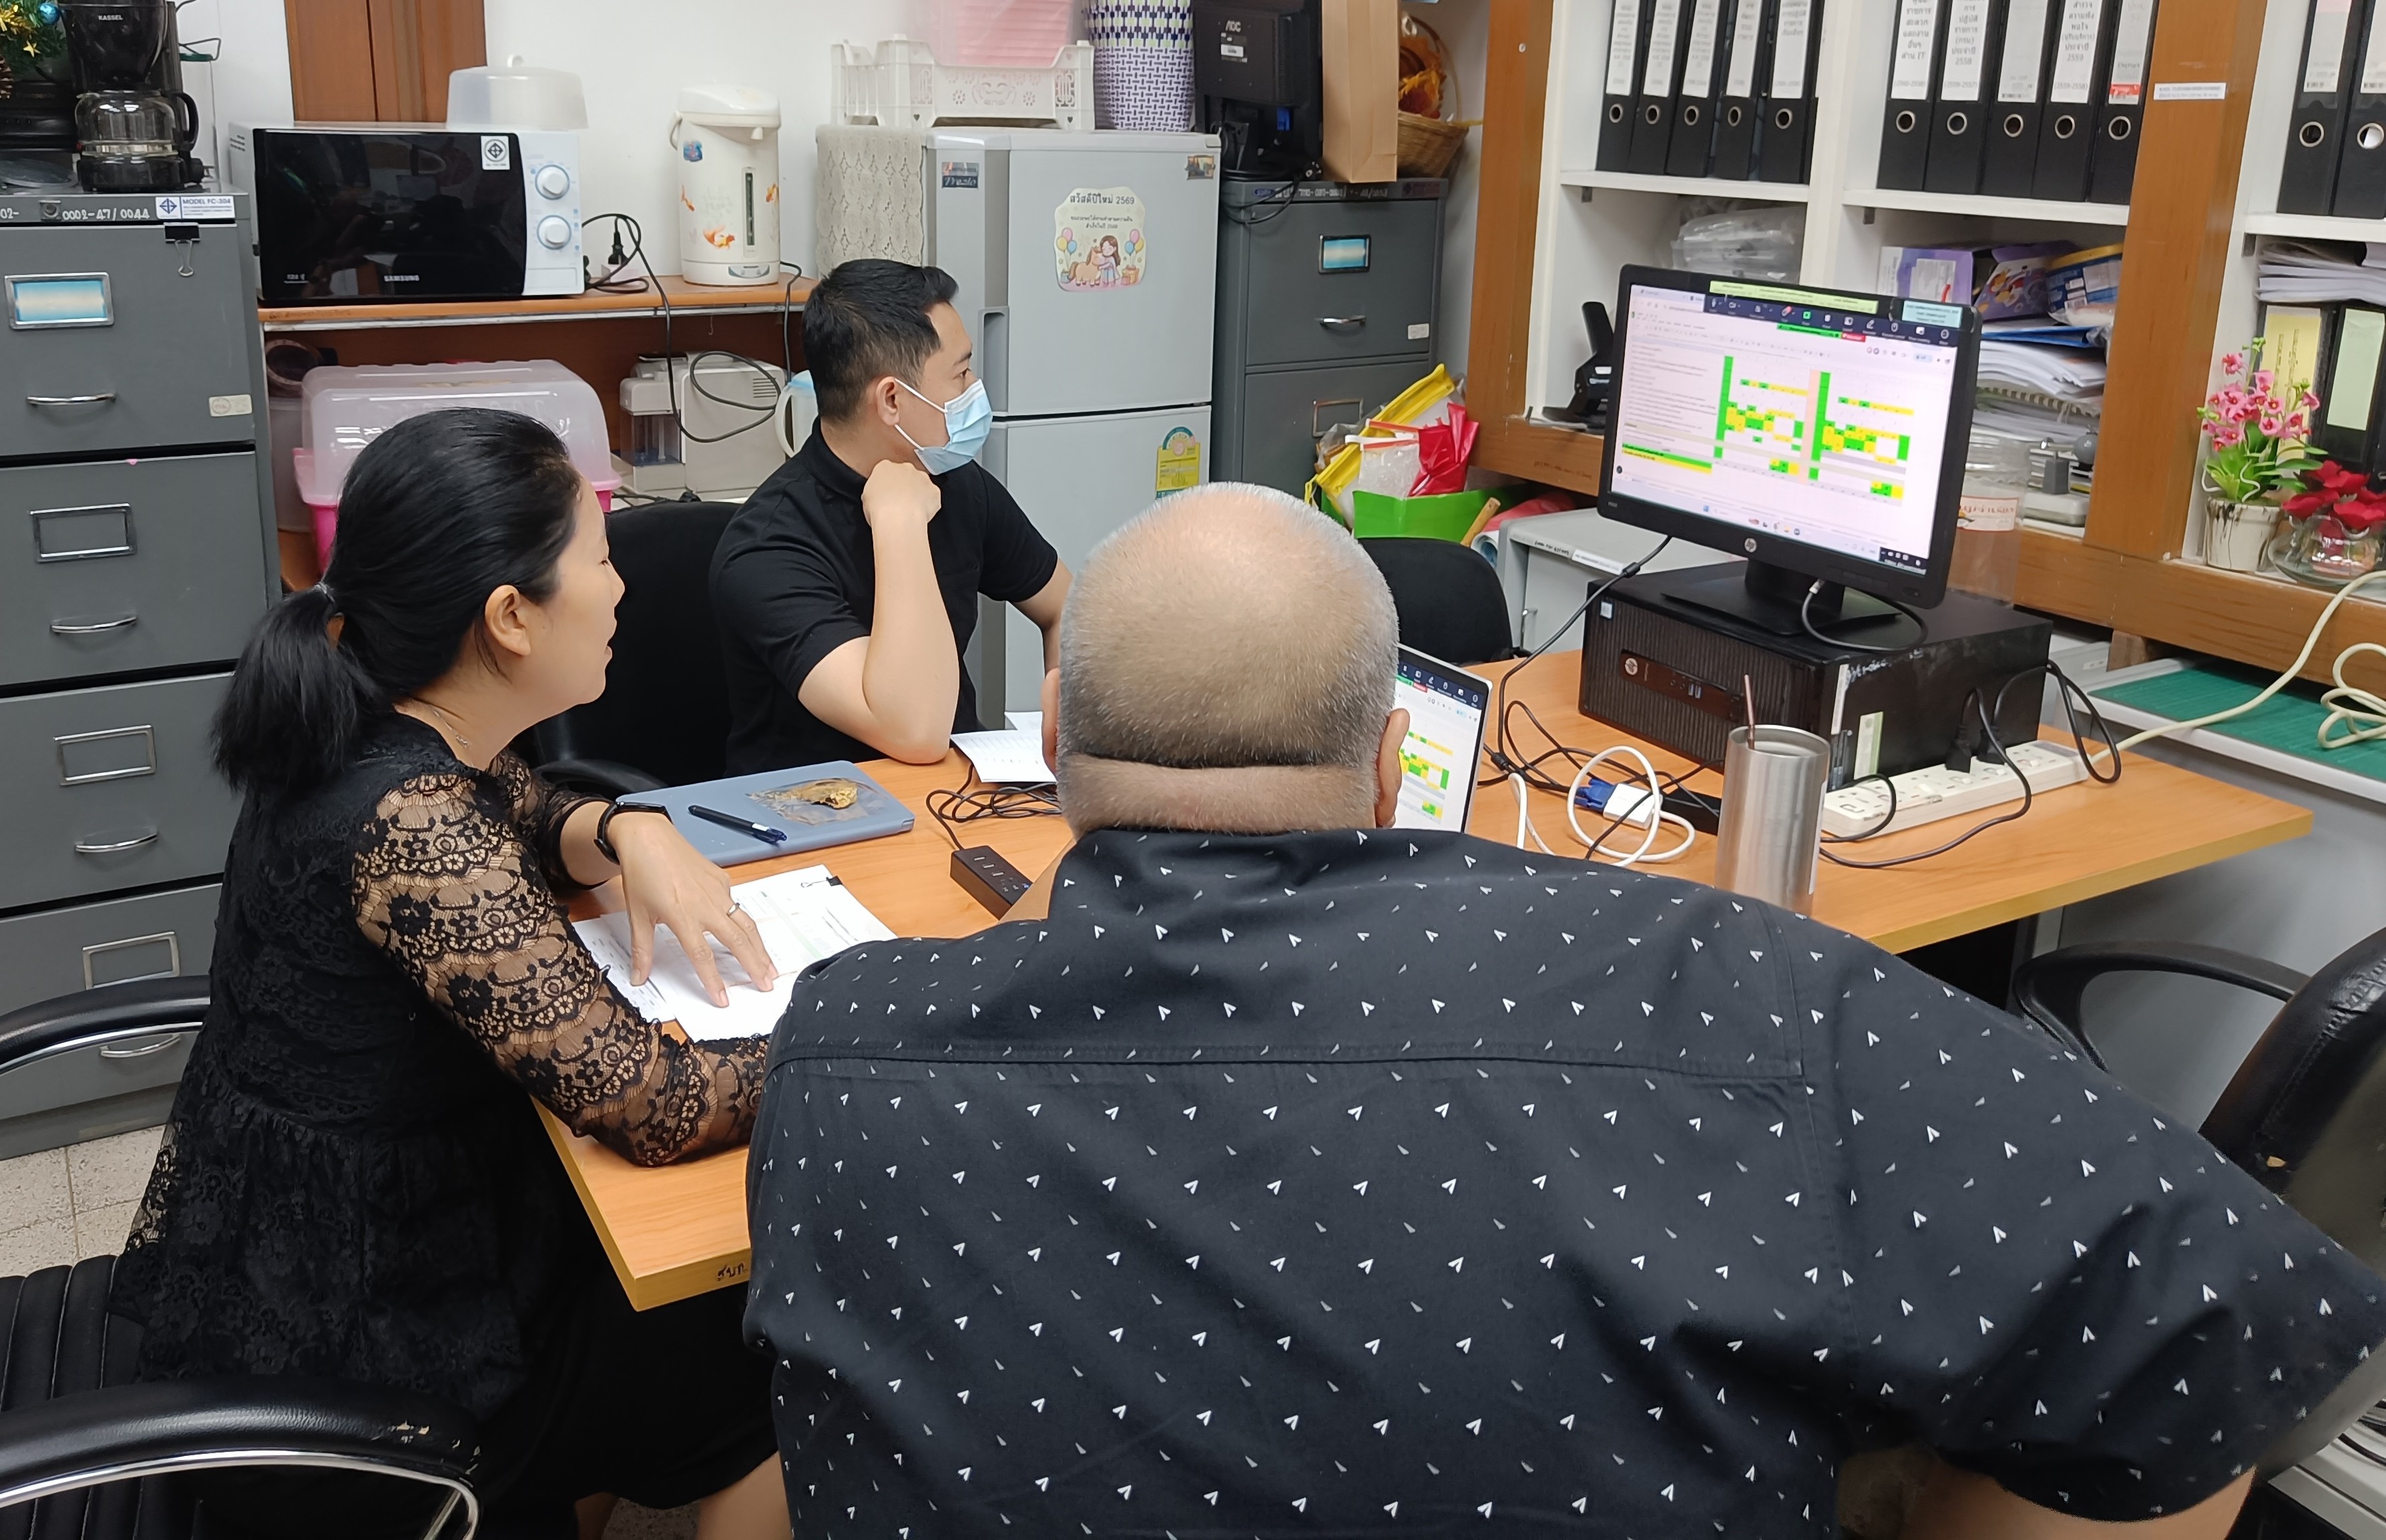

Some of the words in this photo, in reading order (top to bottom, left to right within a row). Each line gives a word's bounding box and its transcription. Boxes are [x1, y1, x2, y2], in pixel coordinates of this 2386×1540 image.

[2071, 22, 2089, 31] พอใจ
[1951, 46, 1976, 55] ประจำปี
[2064, 42, 2090, 51] ประจำปี
[1917, 51, 1926, 60] IT
[2066, 53, 2084, 62] 2559
[1069, 192, 1114, 204] สวัสดีปีใหม่
[1116, 196, 1135, 205] 2569
